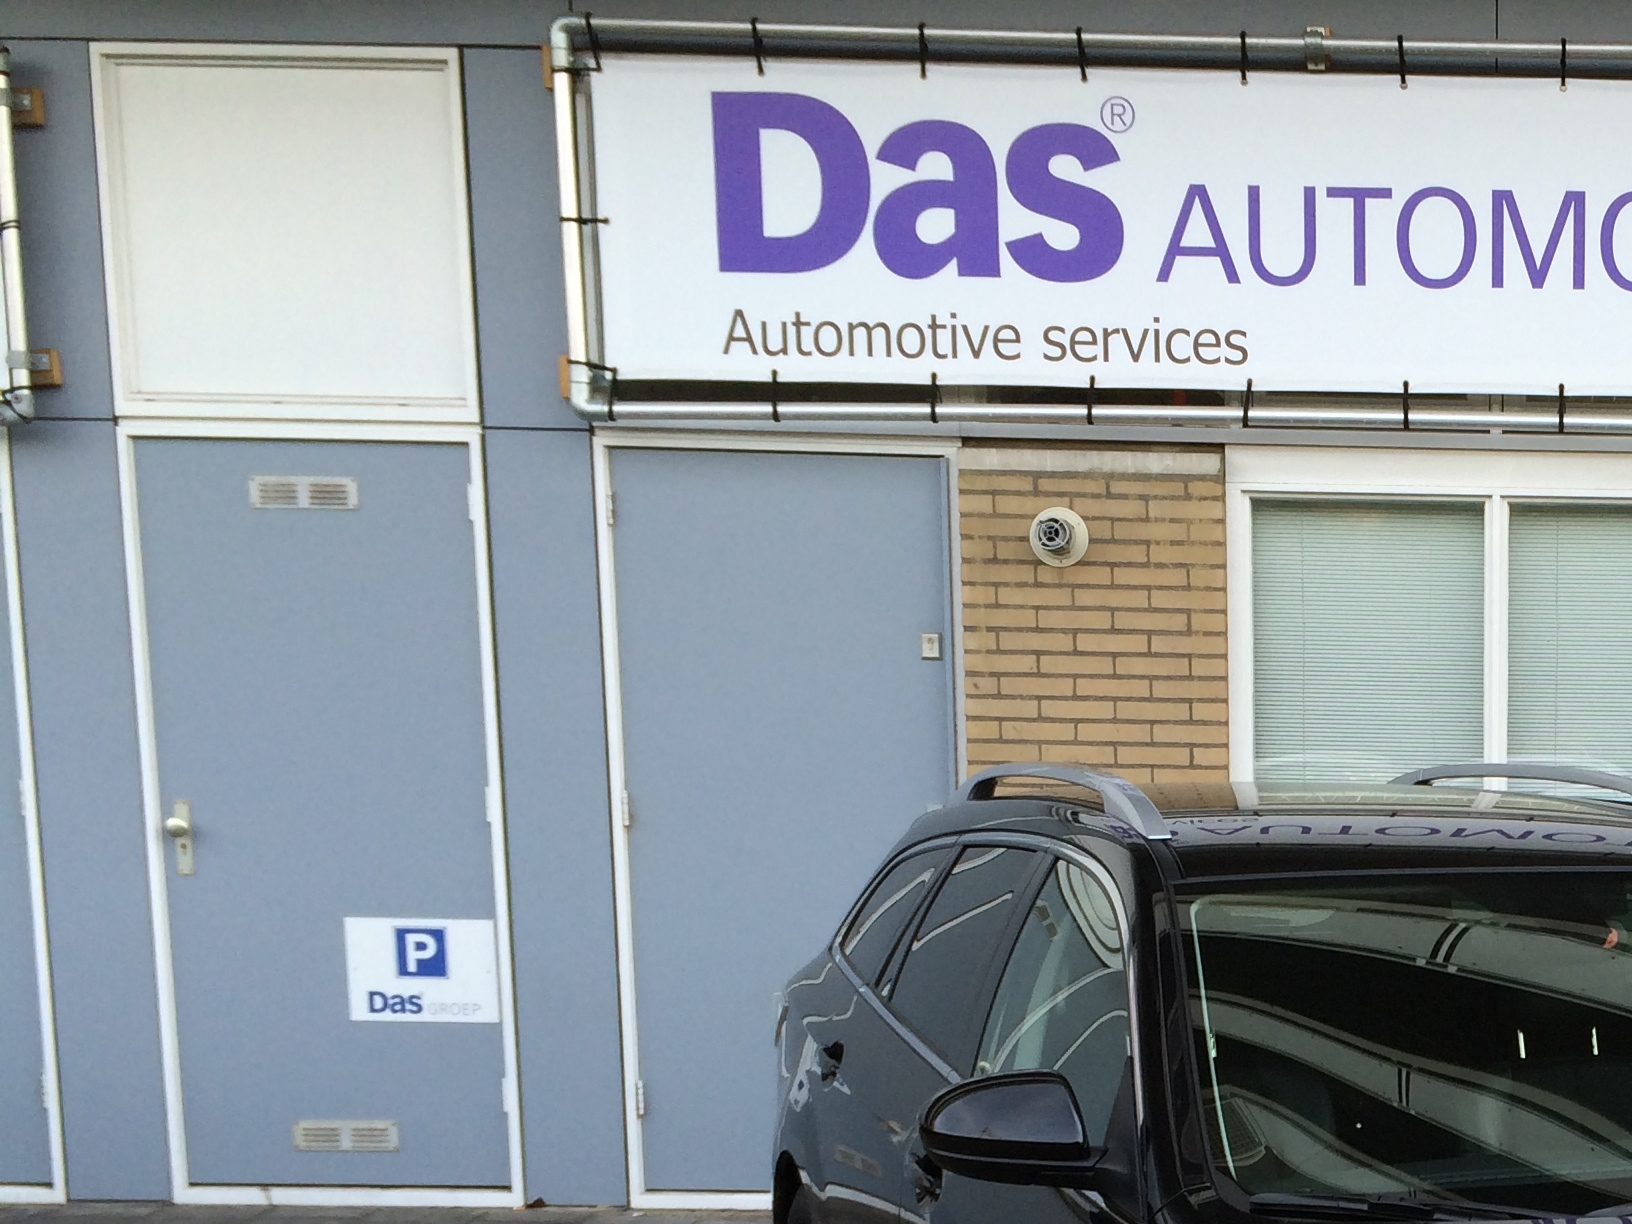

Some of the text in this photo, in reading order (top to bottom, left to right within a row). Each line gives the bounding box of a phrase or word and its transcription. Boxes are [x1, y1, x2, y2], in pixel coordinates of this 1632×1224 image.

[710, 90, 1125, 284] Das
[722, 308, 1250, 365] Automotive services
[404, 932, 438, 973] P
[368, 991, 482, 1016] Das GROEP
